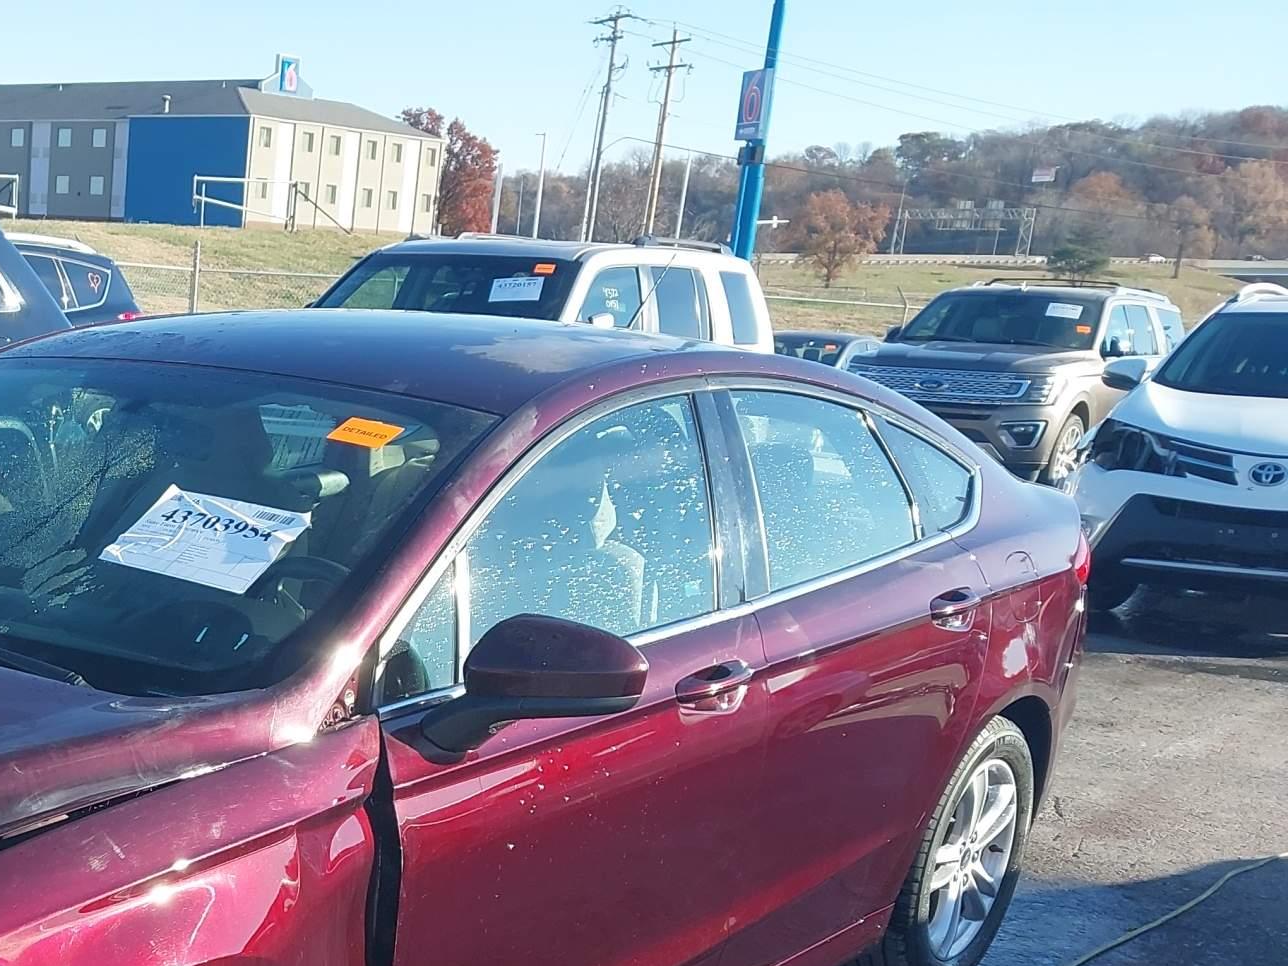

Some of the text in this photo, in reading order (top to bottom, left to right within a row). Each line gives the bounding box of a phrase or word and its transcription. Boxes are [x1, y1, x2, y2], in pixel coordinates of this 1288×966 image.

[743, 71, 761, 122] 6
[343, 426, 388, 440] DETAILED
[160, 507, 274, 542] 43703954
